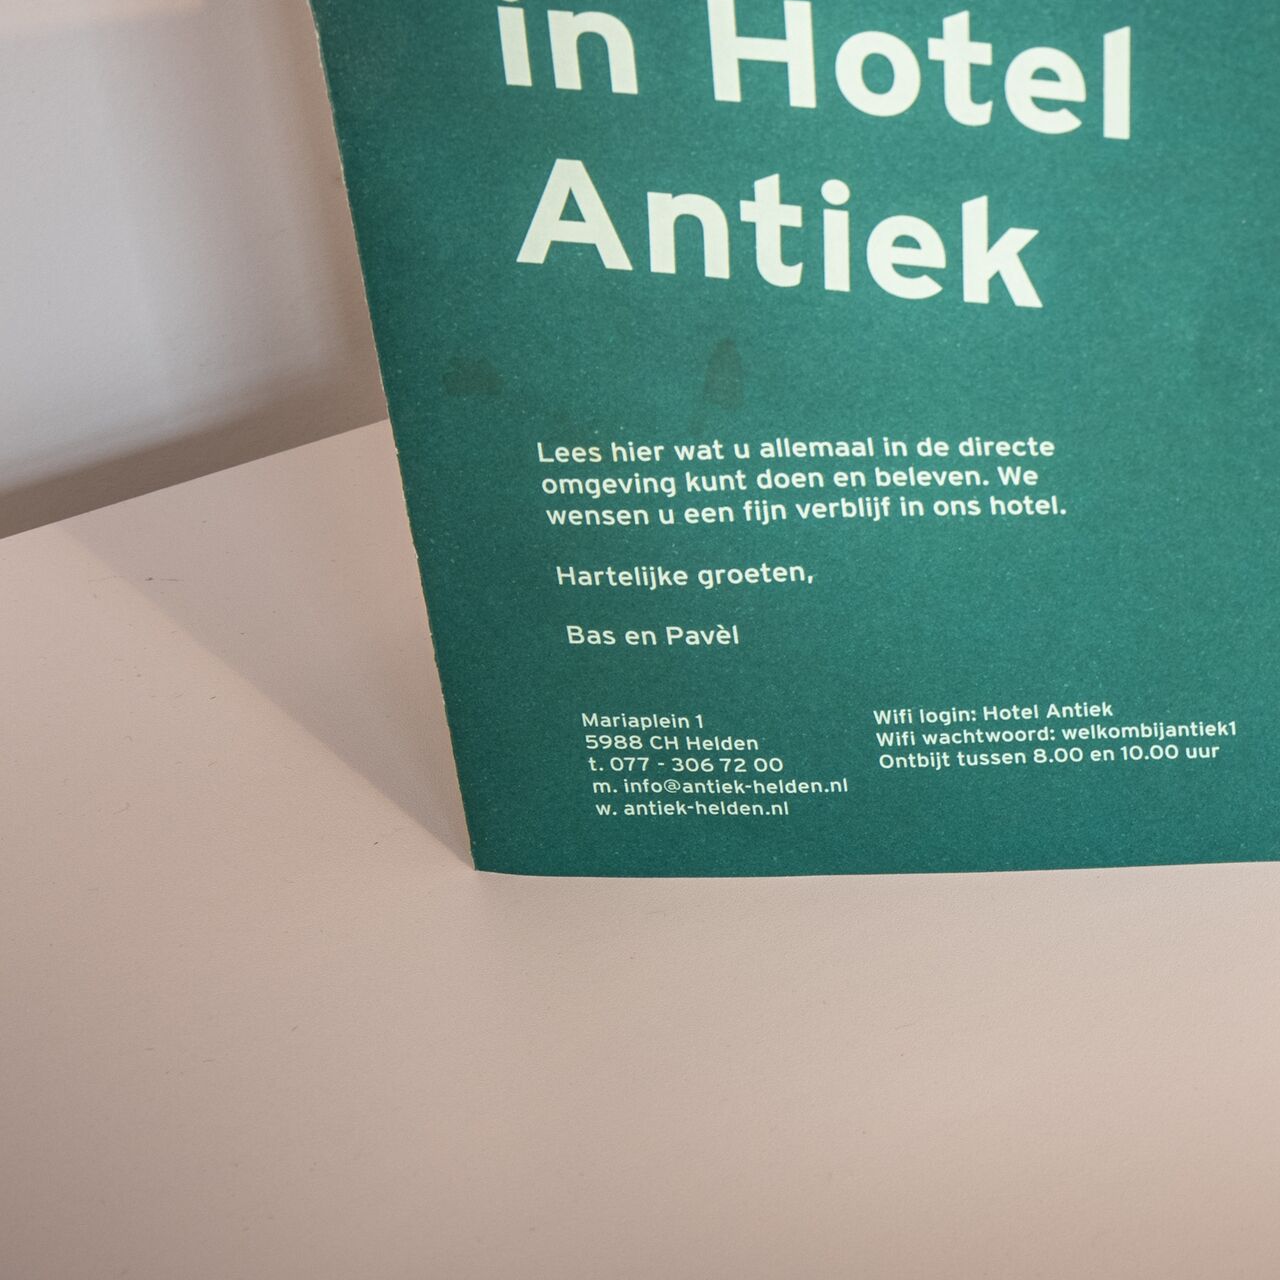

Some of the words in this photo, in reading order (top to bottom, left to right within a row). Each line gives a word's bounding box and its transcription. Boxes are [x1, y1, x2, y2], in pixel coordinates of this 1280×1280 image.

[517, 159, 1042, 307] Antiek
[537, 442, 602, 463] Lees
[611, 441, 664, 462] hier
[674, 439, 724, 461] wat
[734, 443, 750, 459] u
[760, 437, 874, 458] allemaal
[883, 437, 908, 457] in
[917, 437, 950, 457] de
[959, 436, 1055, 457] directe
[542, 473, 676, 499] omgeving
[685, 470, 747, 492] kunt
[756, 468, 824, 489] doen
[833, 471, 866, 487] en
[875, 466, 989, 487] beleven.
[997, 466, 1038, 486] We
[546, 509, 649, 526] wensen
[659, 509, 674, 525] u
[684, 506, 734, 524] een
[743, 500, 787, 525] fijn
[795, 496, 891, 521] verblijf
[900, 496, 924, 516] in
[933, 496, 981, 516] ons
[990, 495, 1066, 515] hotel.
[556, 566, 688, 590] Hartelijke
[698, 562, 814, 589] groeten,
[566, 625, 616, 645] Bas
[625, 630, 657, 645] en
[666, 624, 739, 645] Pavèl
[582, 713, 690, 731] Mariaplein
[695, 714, 703, 728] 1
[873, 709, 913, 725] Wifi
[920, 707, 976, 726] login:
[983, 704, 1039, 721] Hotel
[1046, 701, 1113, 718] Antiek
[585, 735, 643, 749] 5988
[650, 736, 679, 750] CH
[686, 736, 759, 751] Helden
[876, 731, 915, 747] Wifi
[922, 726, 1055, 745] wachtwoord:
[1062, 721, 1236, 740] welkombijantiek1
[588, 757, 603, 771] t.
[610, 757, 649, 771] 077
[672, 758, 714, 772] 306
[719, 758, 747, 772] 72
[754, 757, 783, 772] 00
[879, 752, 950, 770] Ontbijt
[957, 751, 1026, 766] tussen
[1034, 747, 1083, 763] 8.00
[1090, 749, 1115, 761] en
[1120, 744, 1179, 760] 10.00
[1186, 746, 1220, 759] uur
[593, 782, 617, 793] m.
[624, 778, 848, 794] info@antiek-helden.nl
[595, 804, 617, 815] w.
[624, 801, 789, 815] antiek-helden.nl
